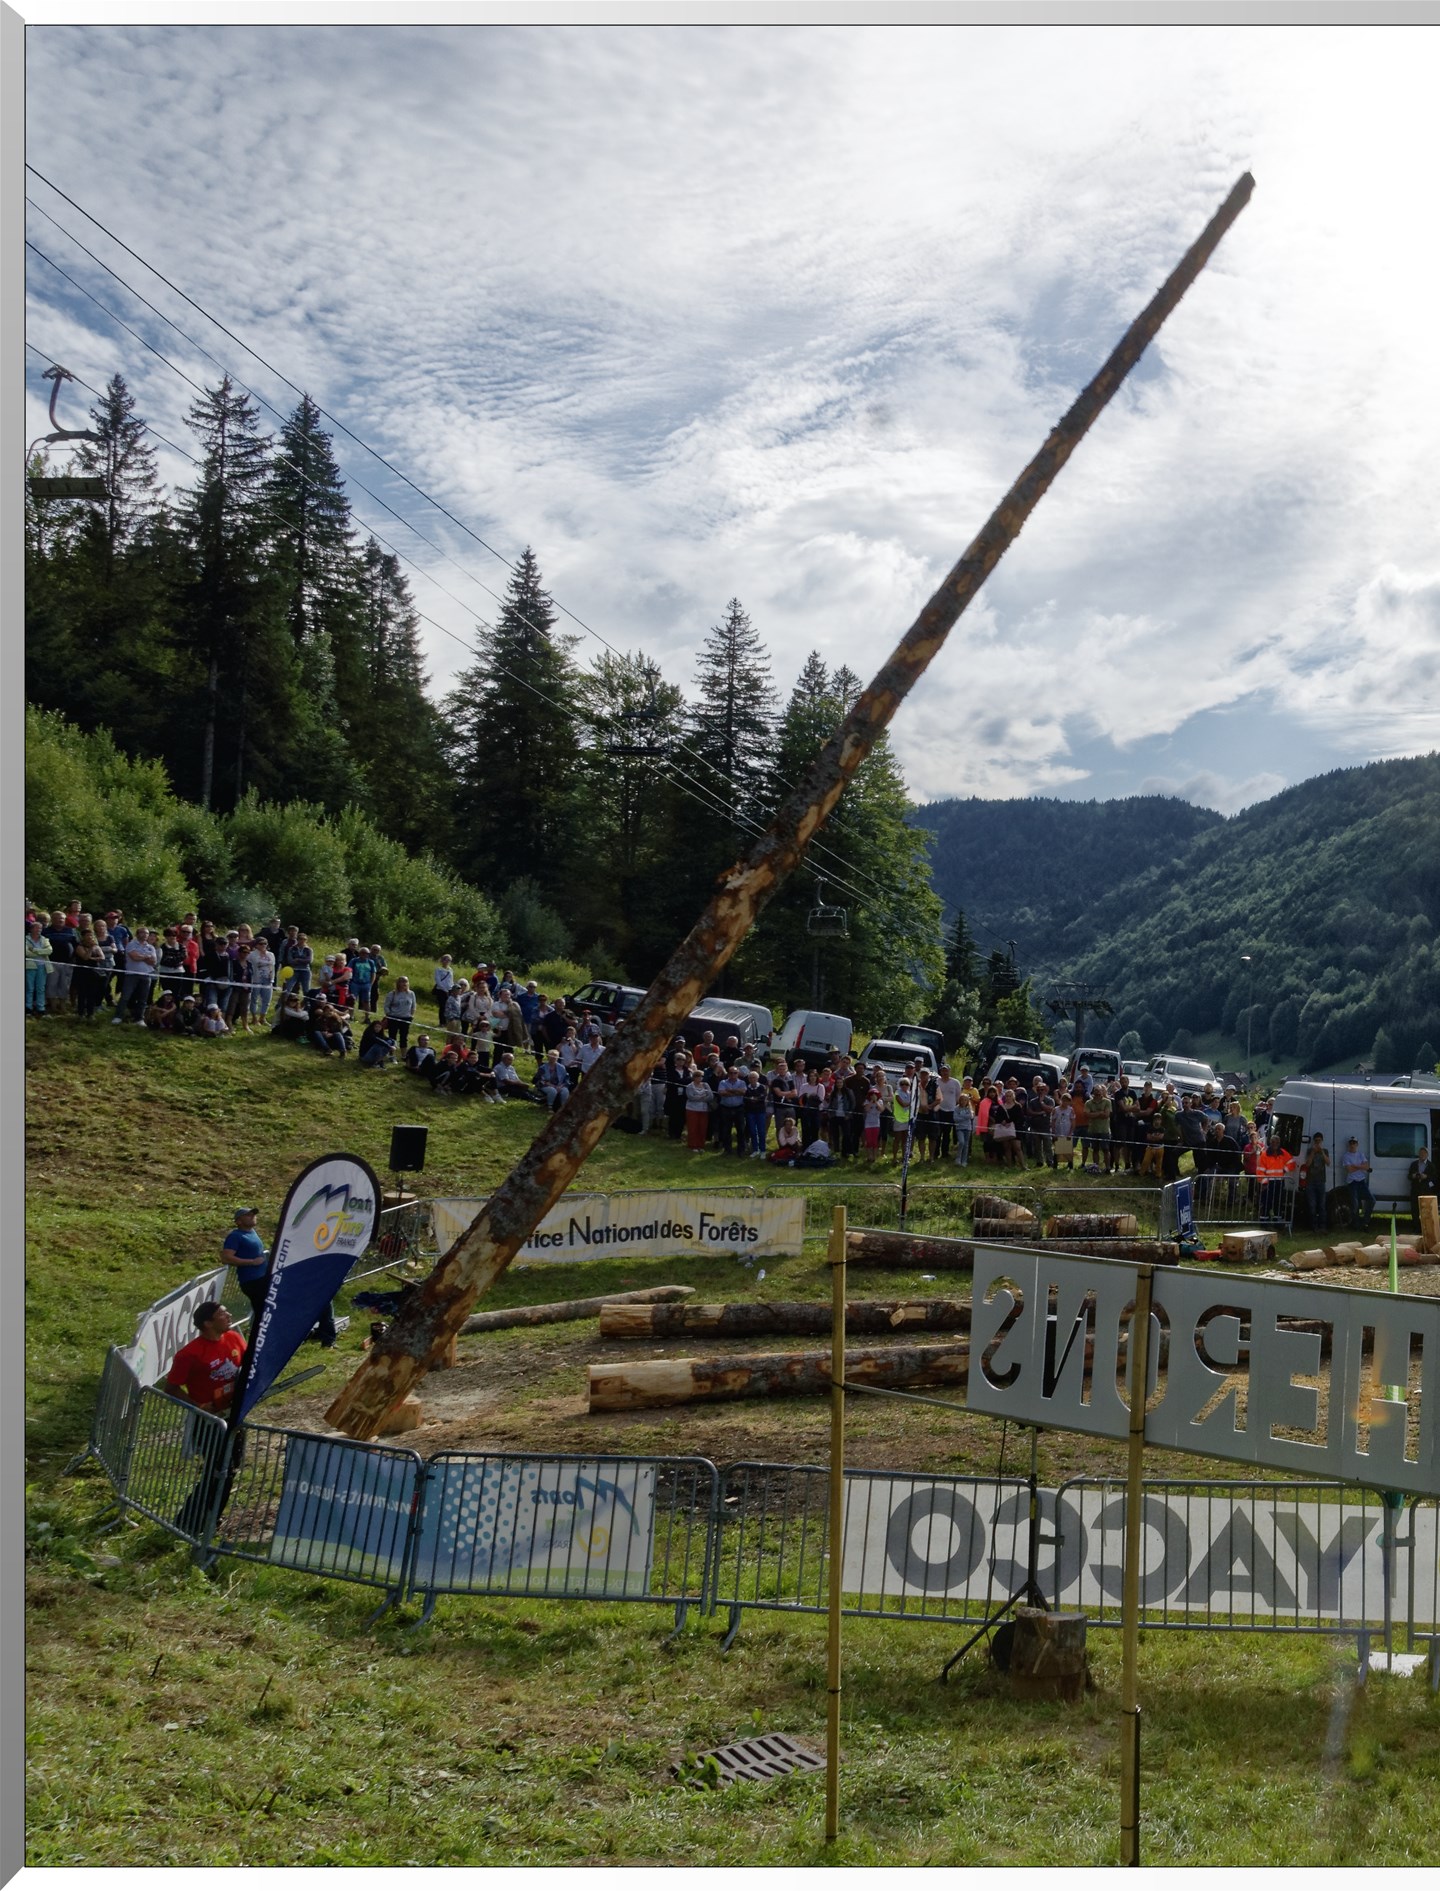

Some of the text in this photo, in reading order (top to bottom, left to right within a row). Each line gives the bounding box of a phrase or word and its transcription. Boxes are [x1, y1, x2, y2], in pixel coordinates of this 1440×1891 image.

[569, 1216, 659, 1246] National
[660, 1220, 694, 1240] des
[698, 1212, 759, 1242] Forêts
